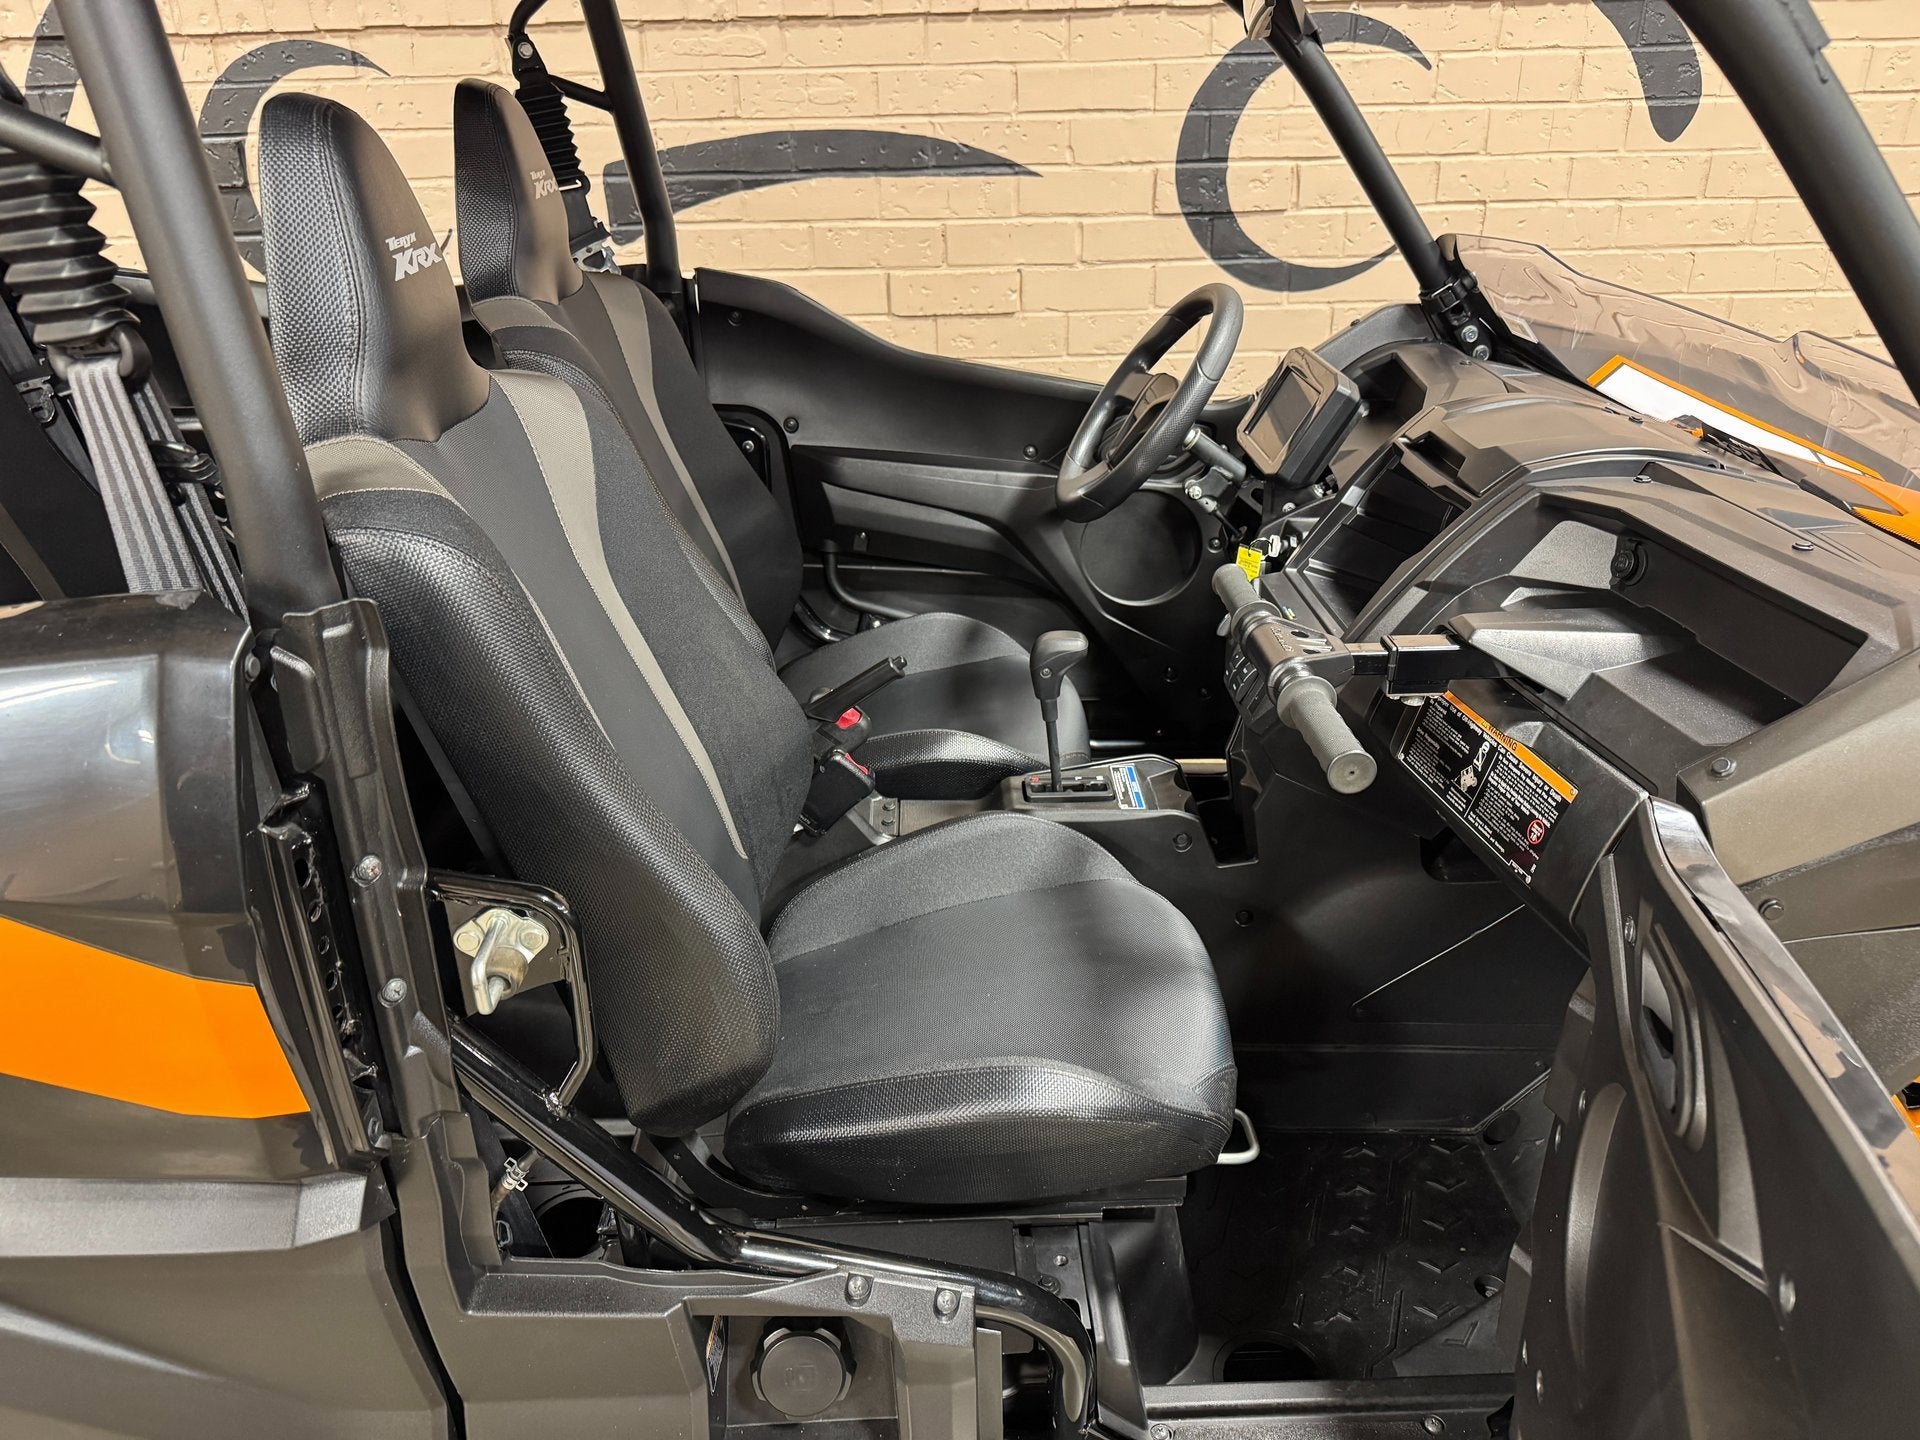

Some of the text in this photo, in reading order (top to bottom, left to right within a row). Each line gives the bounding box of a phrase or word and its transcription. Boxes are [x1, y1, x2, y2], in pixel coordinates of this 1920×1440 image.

[534, 177, 558, 200] KRX
[392, 242, 442, 282] KRX
[1487, 724, 1518, 751] WARNING
